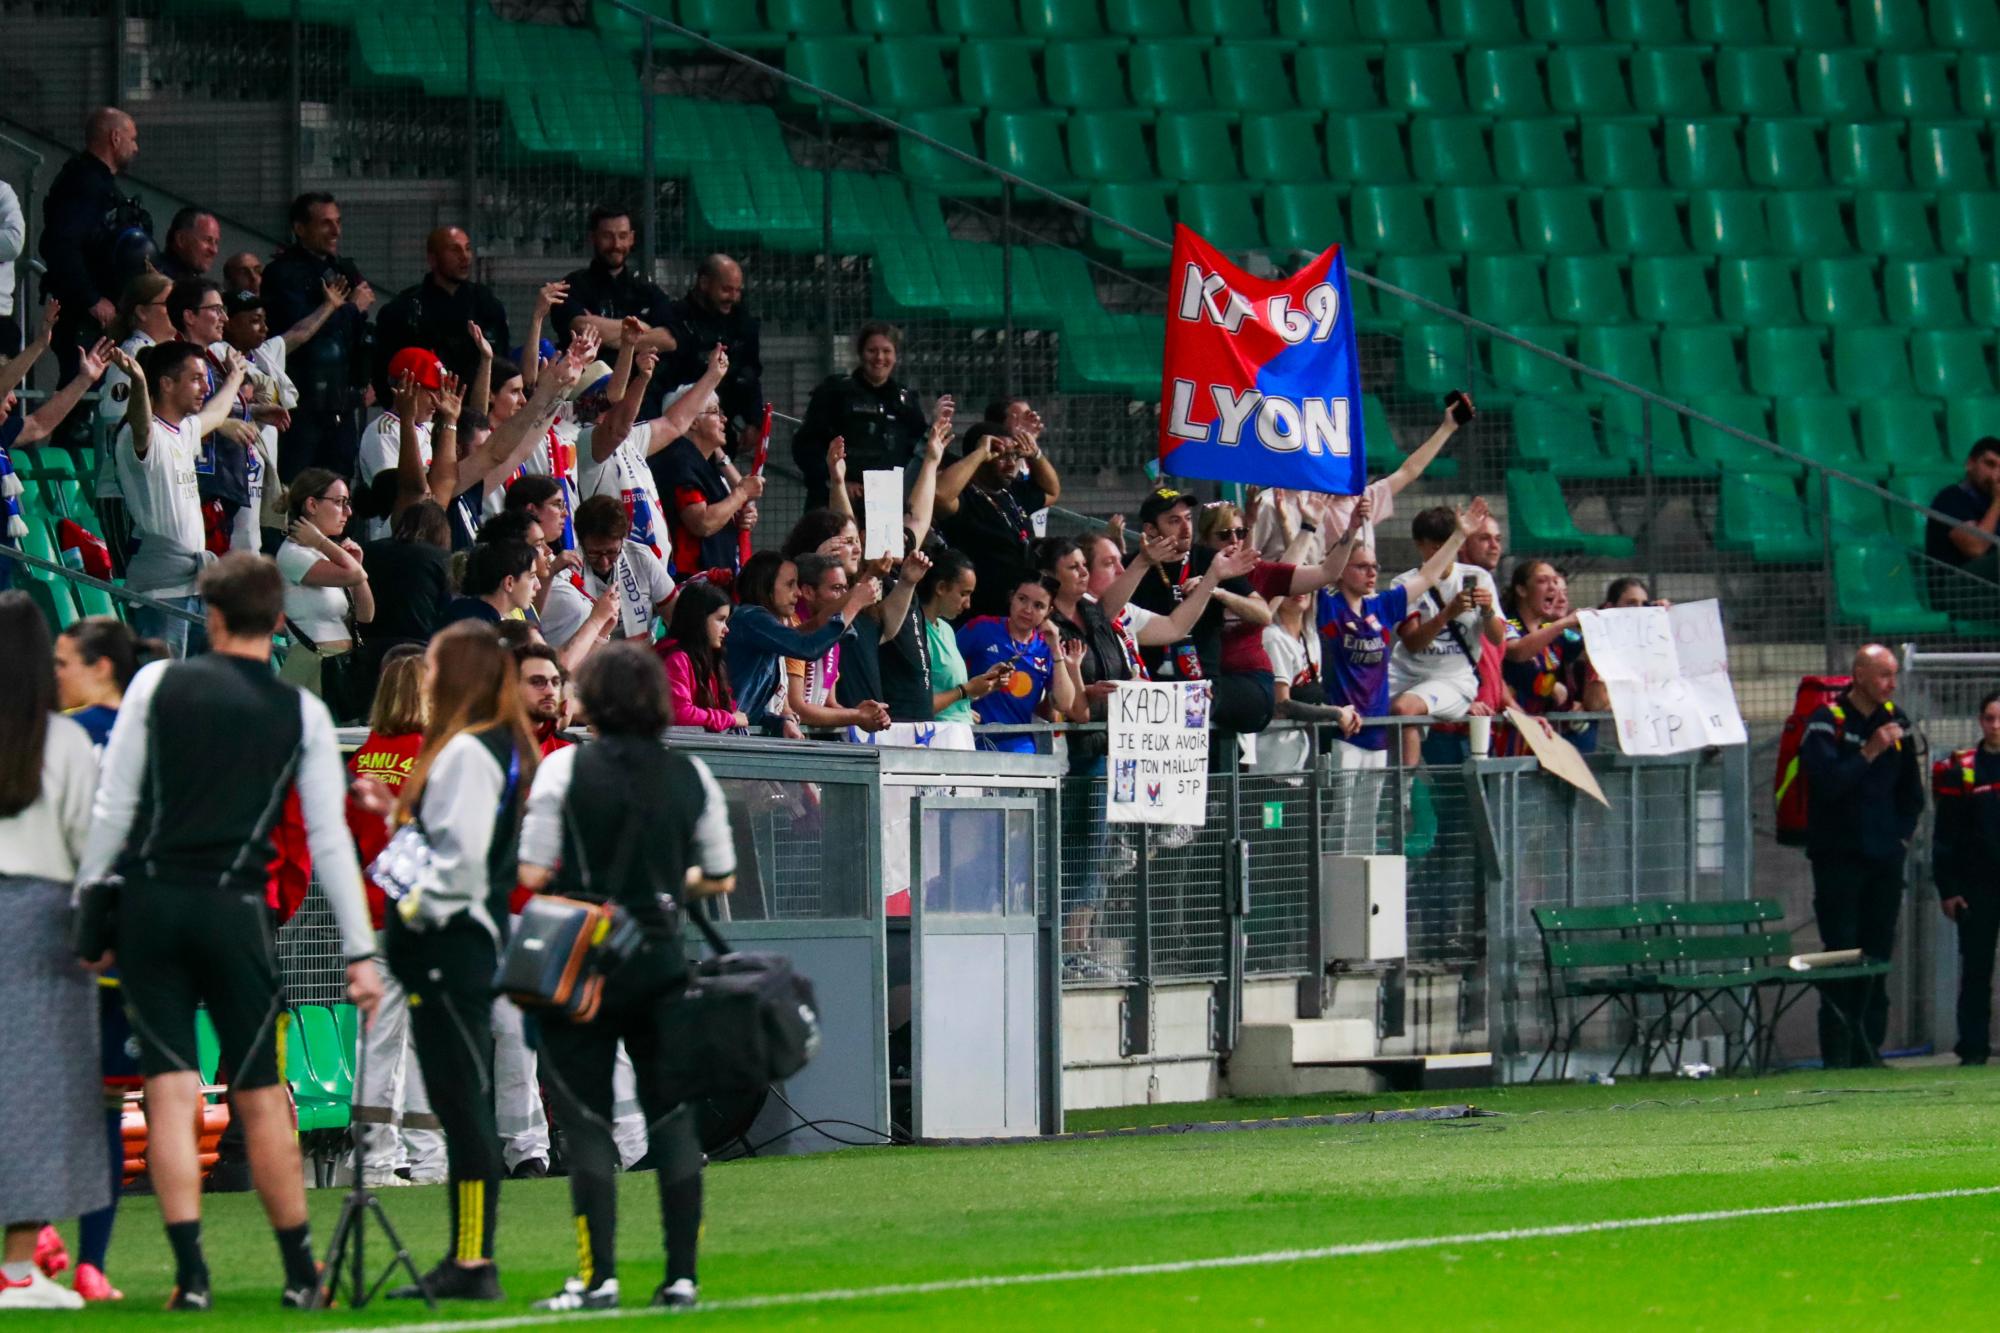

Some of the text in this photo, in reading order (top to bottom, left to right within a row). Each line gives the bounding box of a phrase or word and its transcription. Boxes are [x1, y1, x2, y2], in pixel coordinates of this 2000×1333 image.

[1268, 283, 1339, 344] 69
[1168, 378, 1350, 456] LYON
[634, 604, 648, 625] LE
[1117, 733, 1135, 750] JE
[1142, 733, 1170, 751] PEUX
[1141, 759, 1158, 775] TON
[1177, 780, 1200, 796] STP
